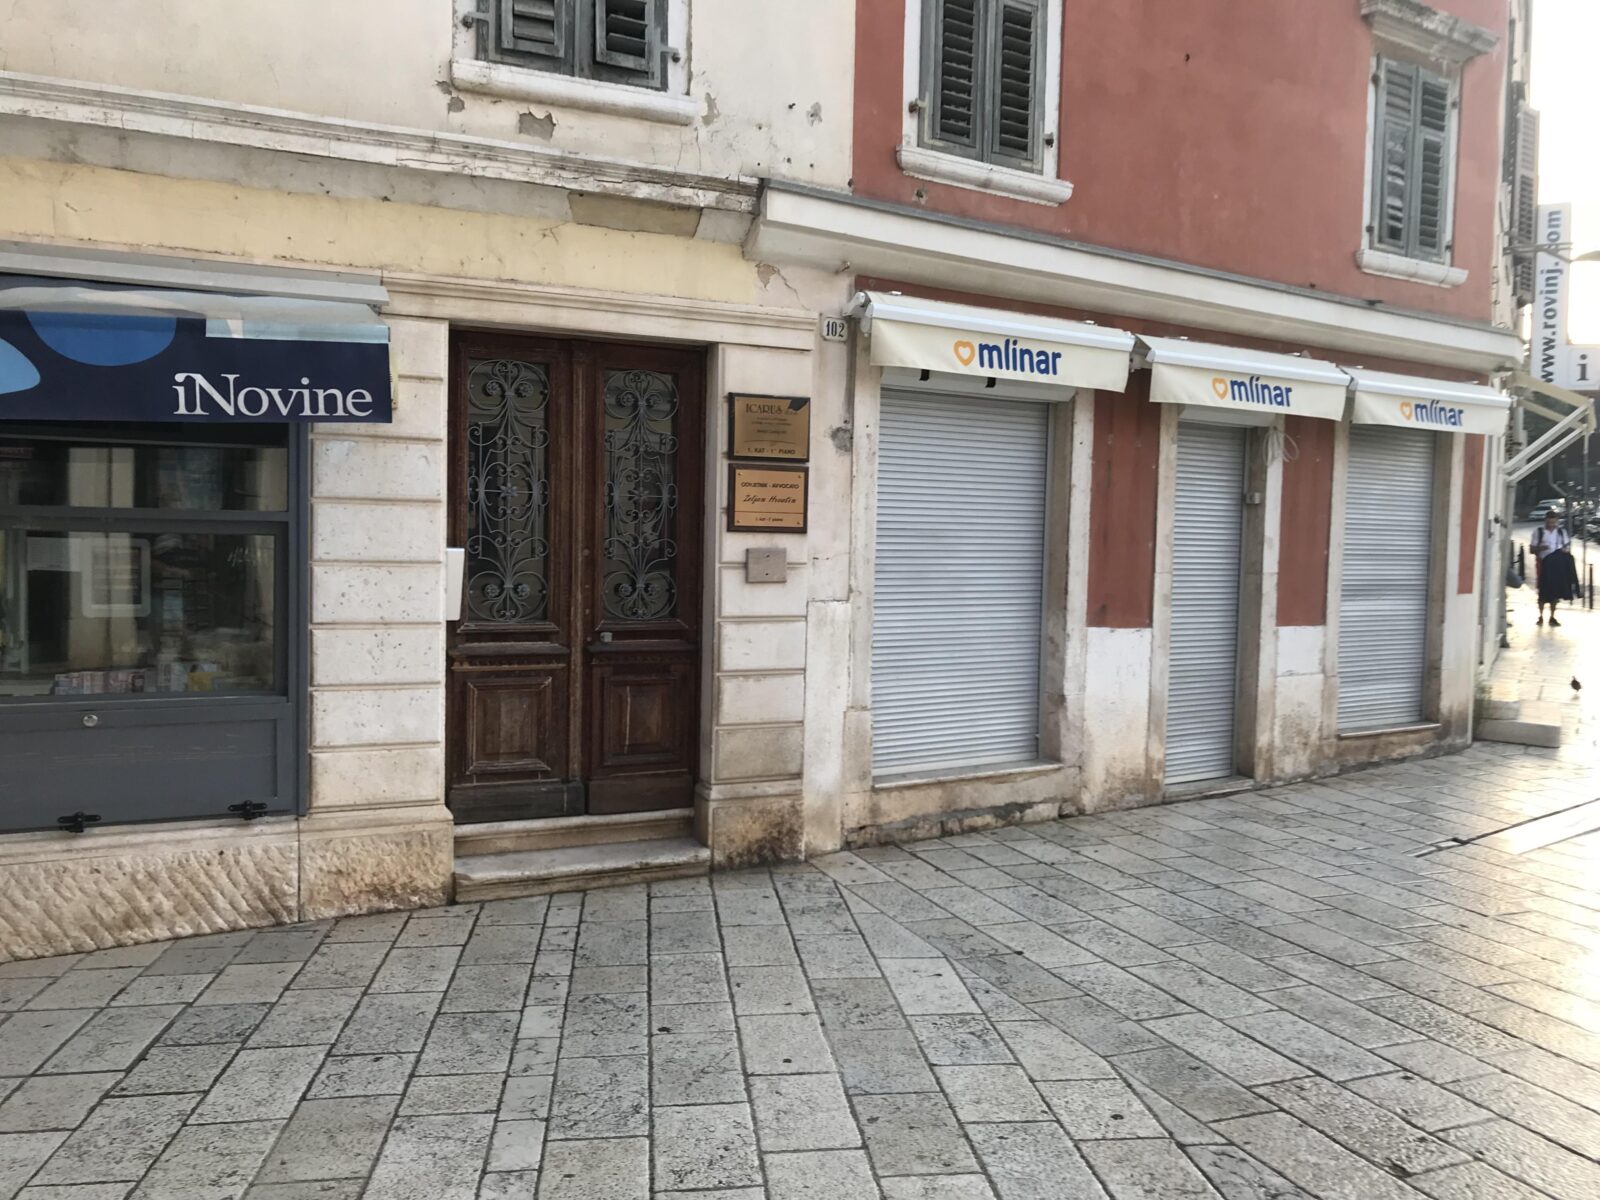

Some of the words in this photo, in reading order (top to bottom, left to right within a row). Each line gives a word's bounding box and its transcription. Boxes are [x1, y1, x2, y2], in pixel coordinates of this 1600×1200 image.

[826, 320, 845, 338] 102
[978, 338, 1062, 376] mlinar
[1576, 354, 1590, 381] i
[172, 372, 373, 417] iNovine
